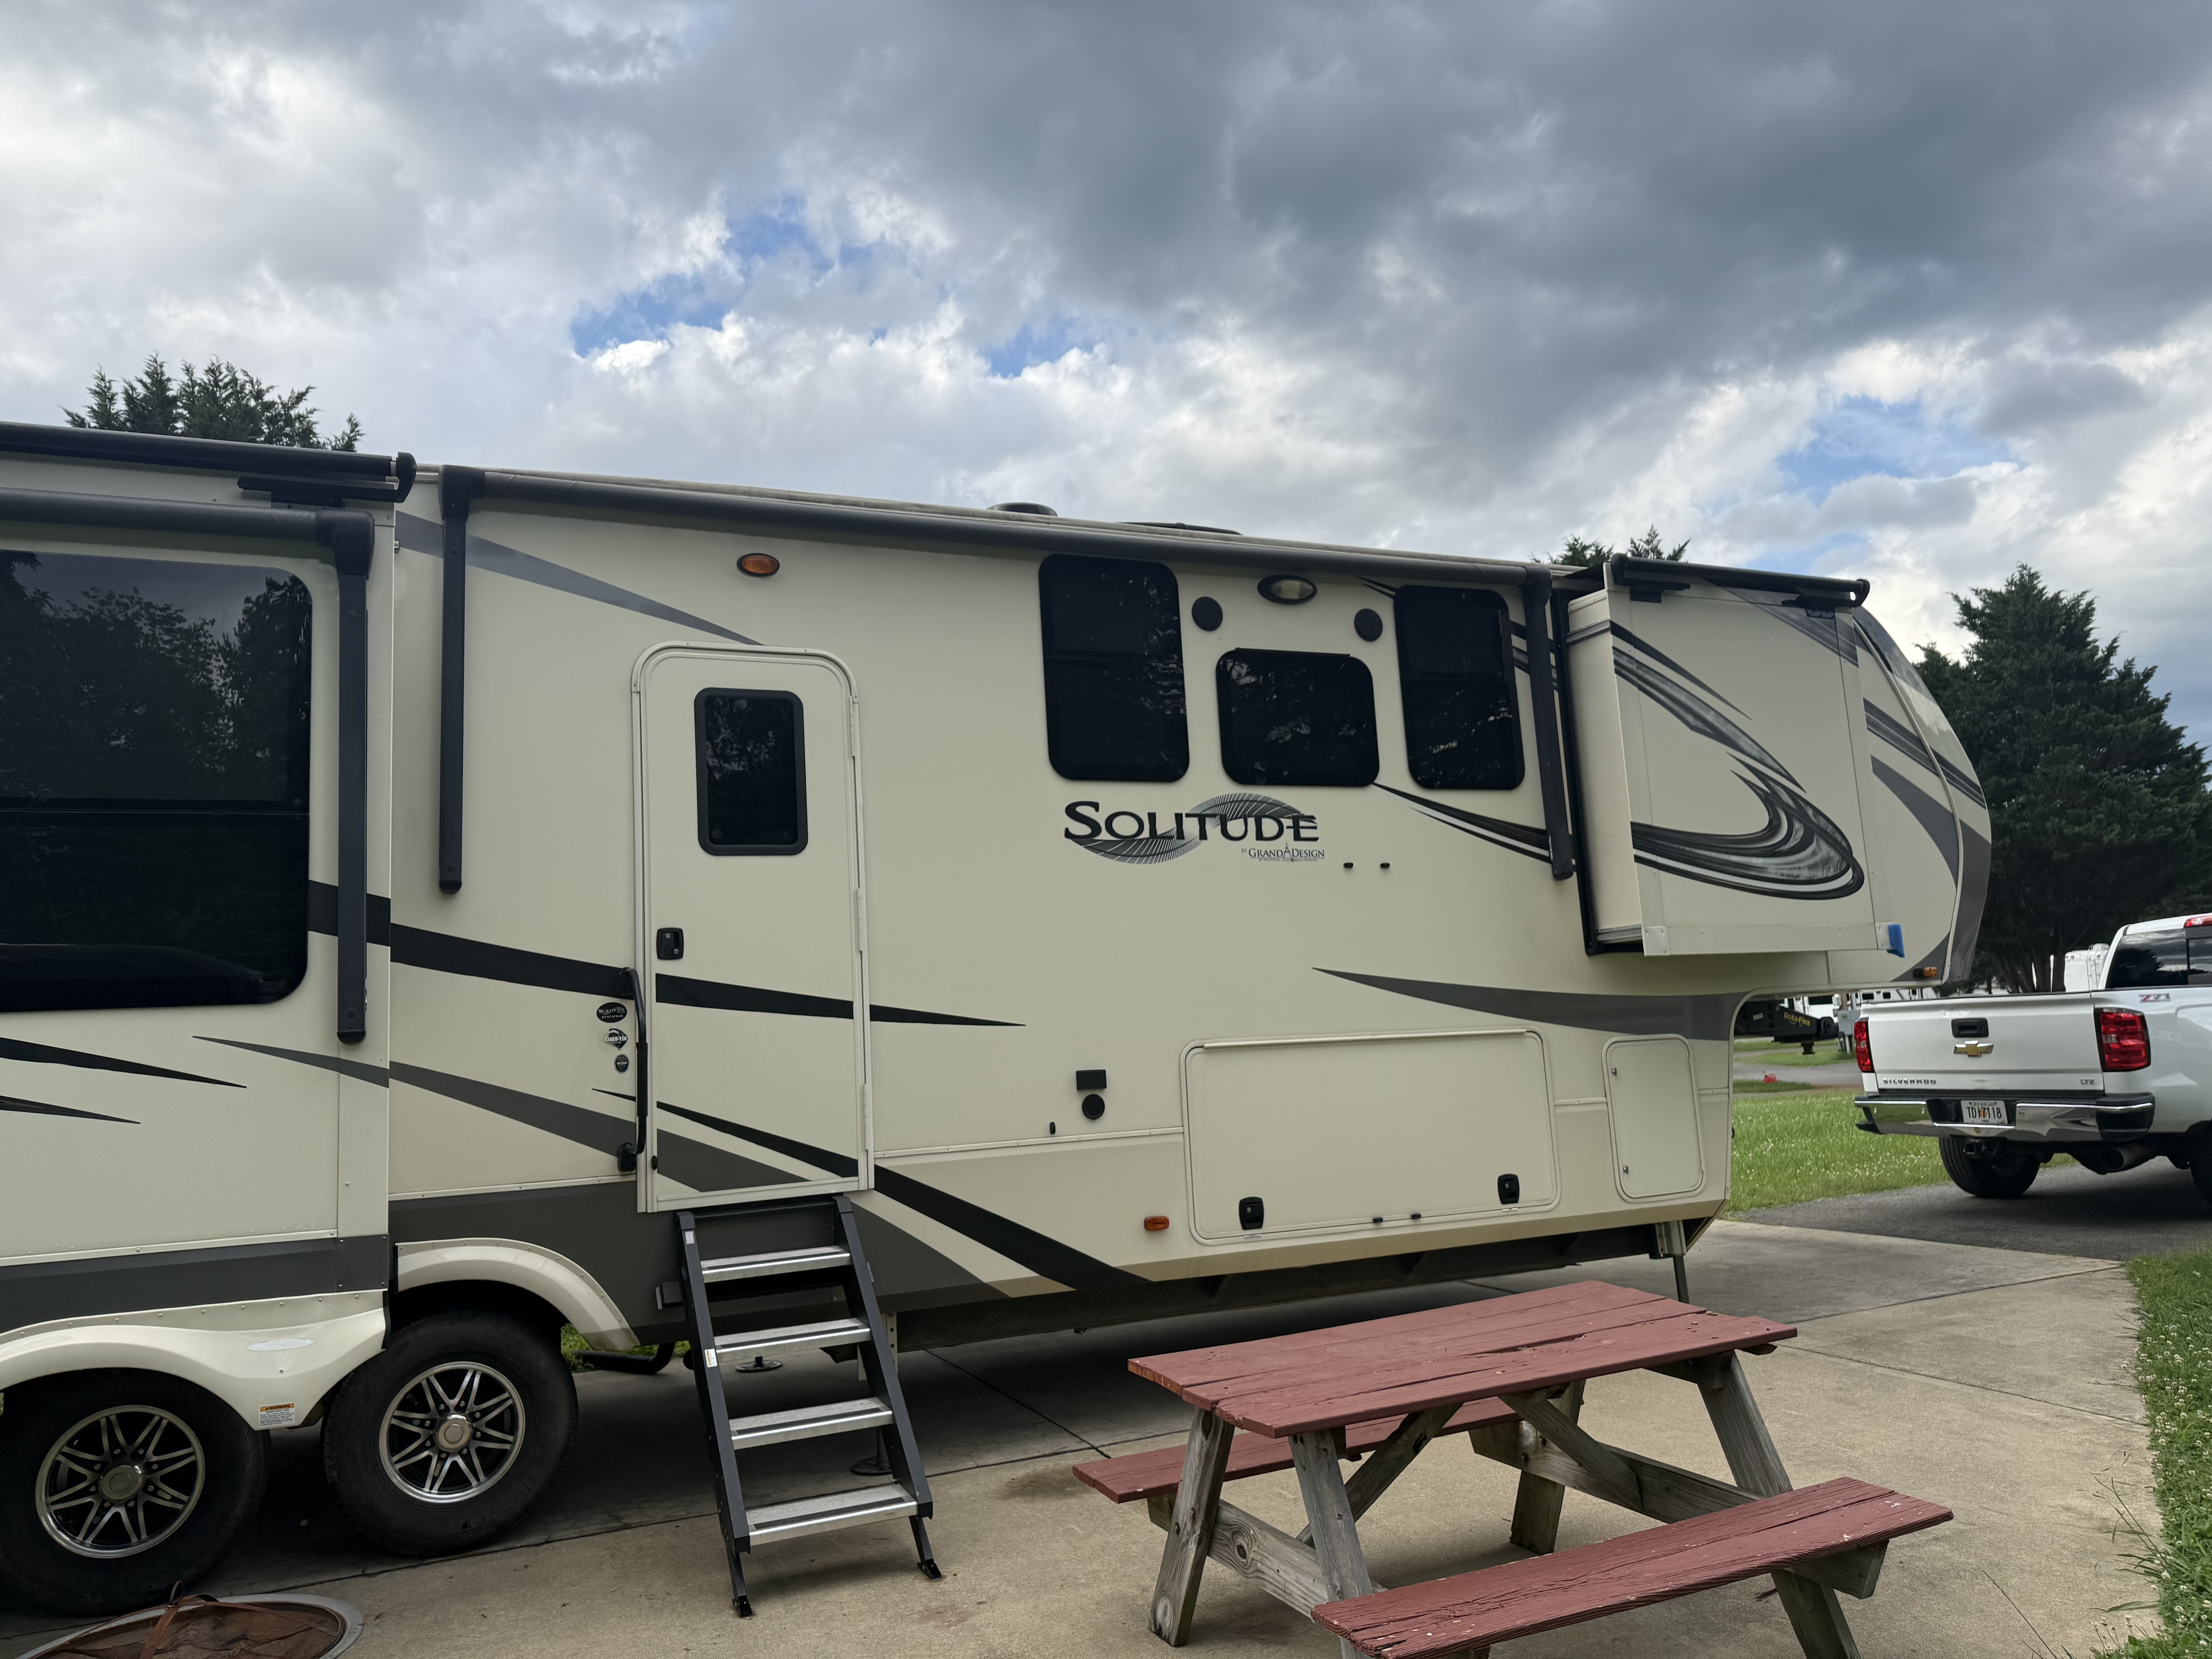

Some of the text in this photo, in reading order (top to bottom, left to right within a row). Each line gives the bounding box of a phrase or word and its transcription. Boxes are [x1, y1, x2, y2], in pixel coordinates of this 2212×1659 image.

[1064, 800, 1319, 842] SOLITUDE
[1249, 848, 1283, 857] GRAND
[1292, 848, 1324, 857] DESIGN
[2138, 993, 2171, 1003] Z71
[1784, 1012, 1810, 1026] Rota-Flex
